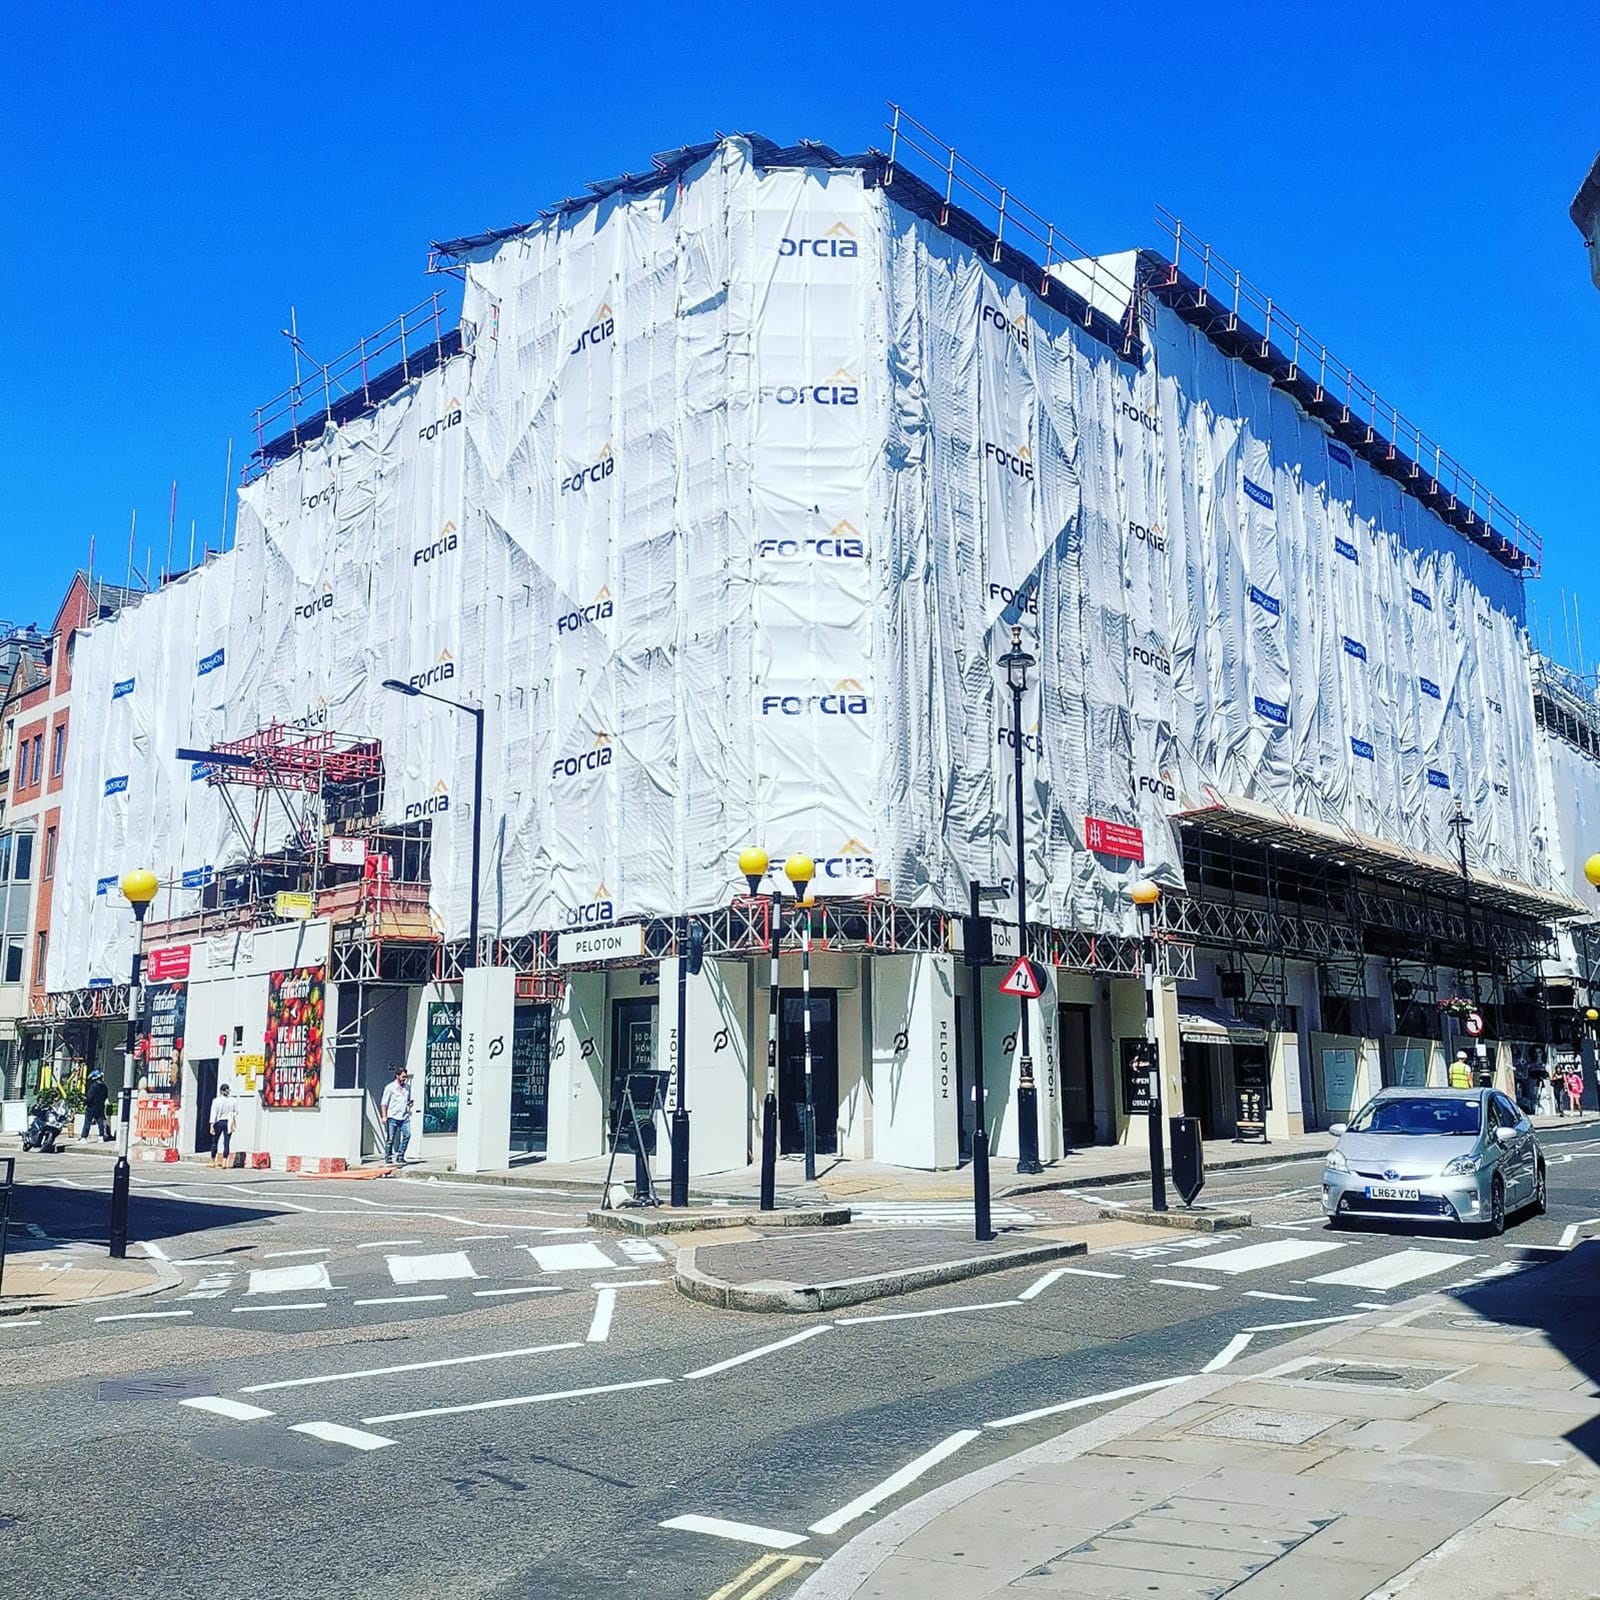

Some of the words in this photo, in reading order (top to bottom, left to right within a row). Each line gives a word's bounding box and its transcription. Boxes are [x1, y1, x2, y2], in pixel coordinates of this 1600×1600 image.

[778, 237, 858, 257] orcia
[766, 857, 875, 879] Frcia
[576, 937, 621, 953] PELOTON
[278, 1026, 289, 1043] WE
[291, 1024, 308, 1042] ARE
[277, 1042, 307, 1056] ORGANIC
[431, 1042, 460, 1051] DELICIO
[430, 1059, 460, 1067] SUSTAINA
[431, 1051, 460, 1059] REVOLUTI
[940, 1021, 949, 1099] PELOTON
[1046, 1026, 1055, 1097] PELOTON
[275, 1067, 305, 1083] ETHICAL
[430, 1067, 460, 1076] SOLUTI
[669, 1028, 678, 1107] PELOTON
[430, 1076, 460, 1086] NURTU
[283, 1083, 305, 1100] OPEN
[1372, 1188, 1397, 1198] LR62
[1399, 1189, 1417, 1199] VZG
